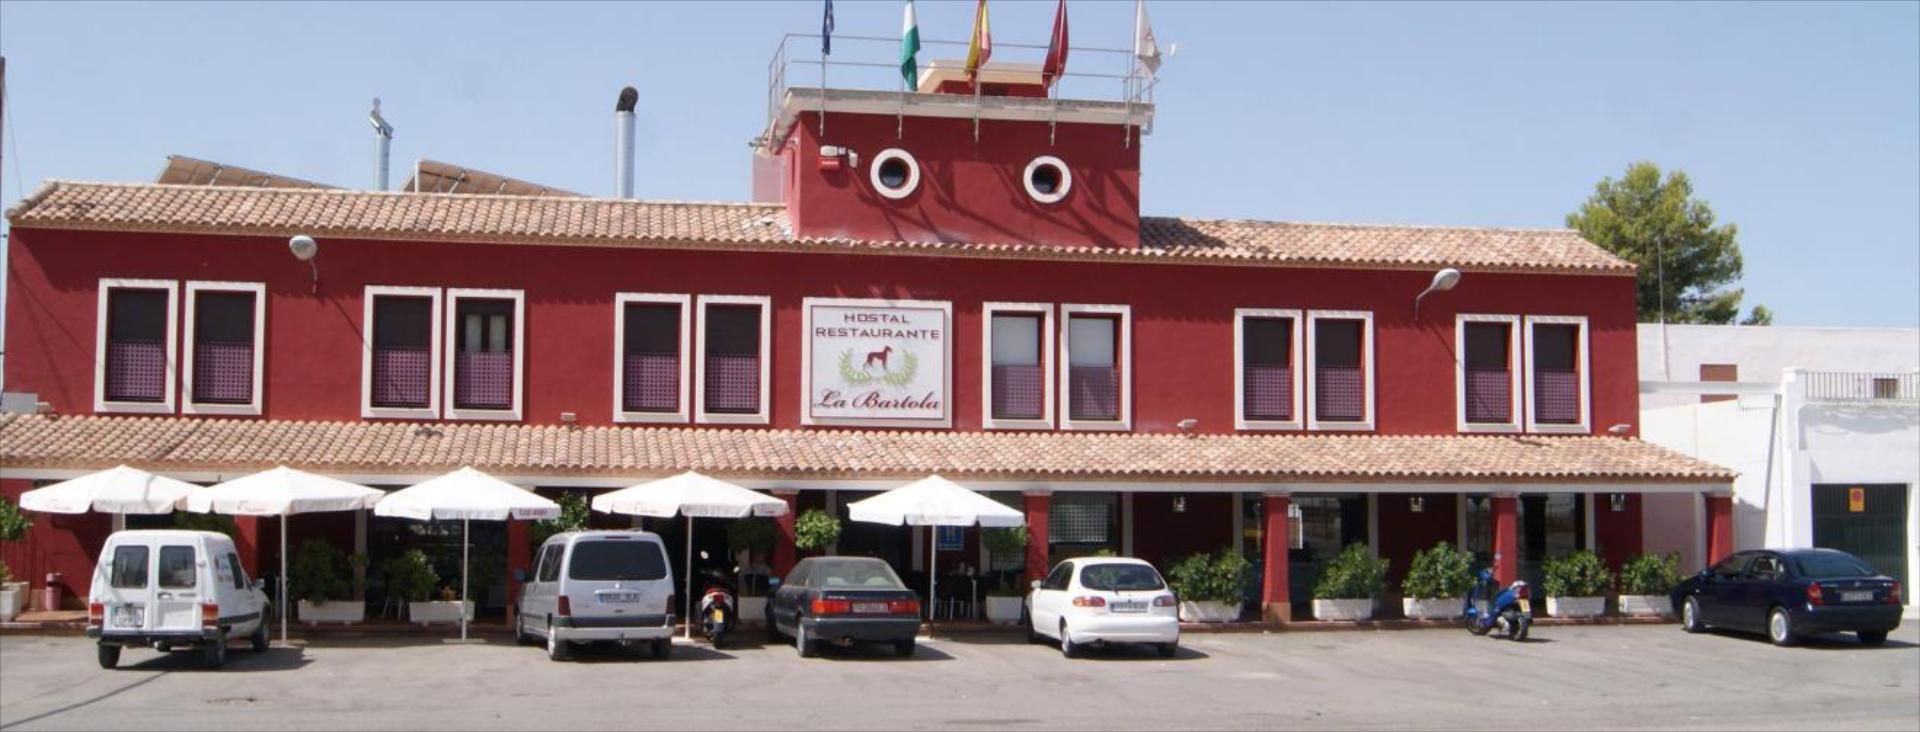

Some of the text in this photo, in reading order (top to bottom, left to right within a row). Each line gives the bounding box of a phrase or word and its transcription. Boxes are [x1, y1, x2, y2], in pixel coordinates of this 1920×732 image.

[843, 313, 911, 324] HOSTAL
[815, 327, 940, 339] RESTAURANTE
[813, 388, 940, 410] La Bartola
